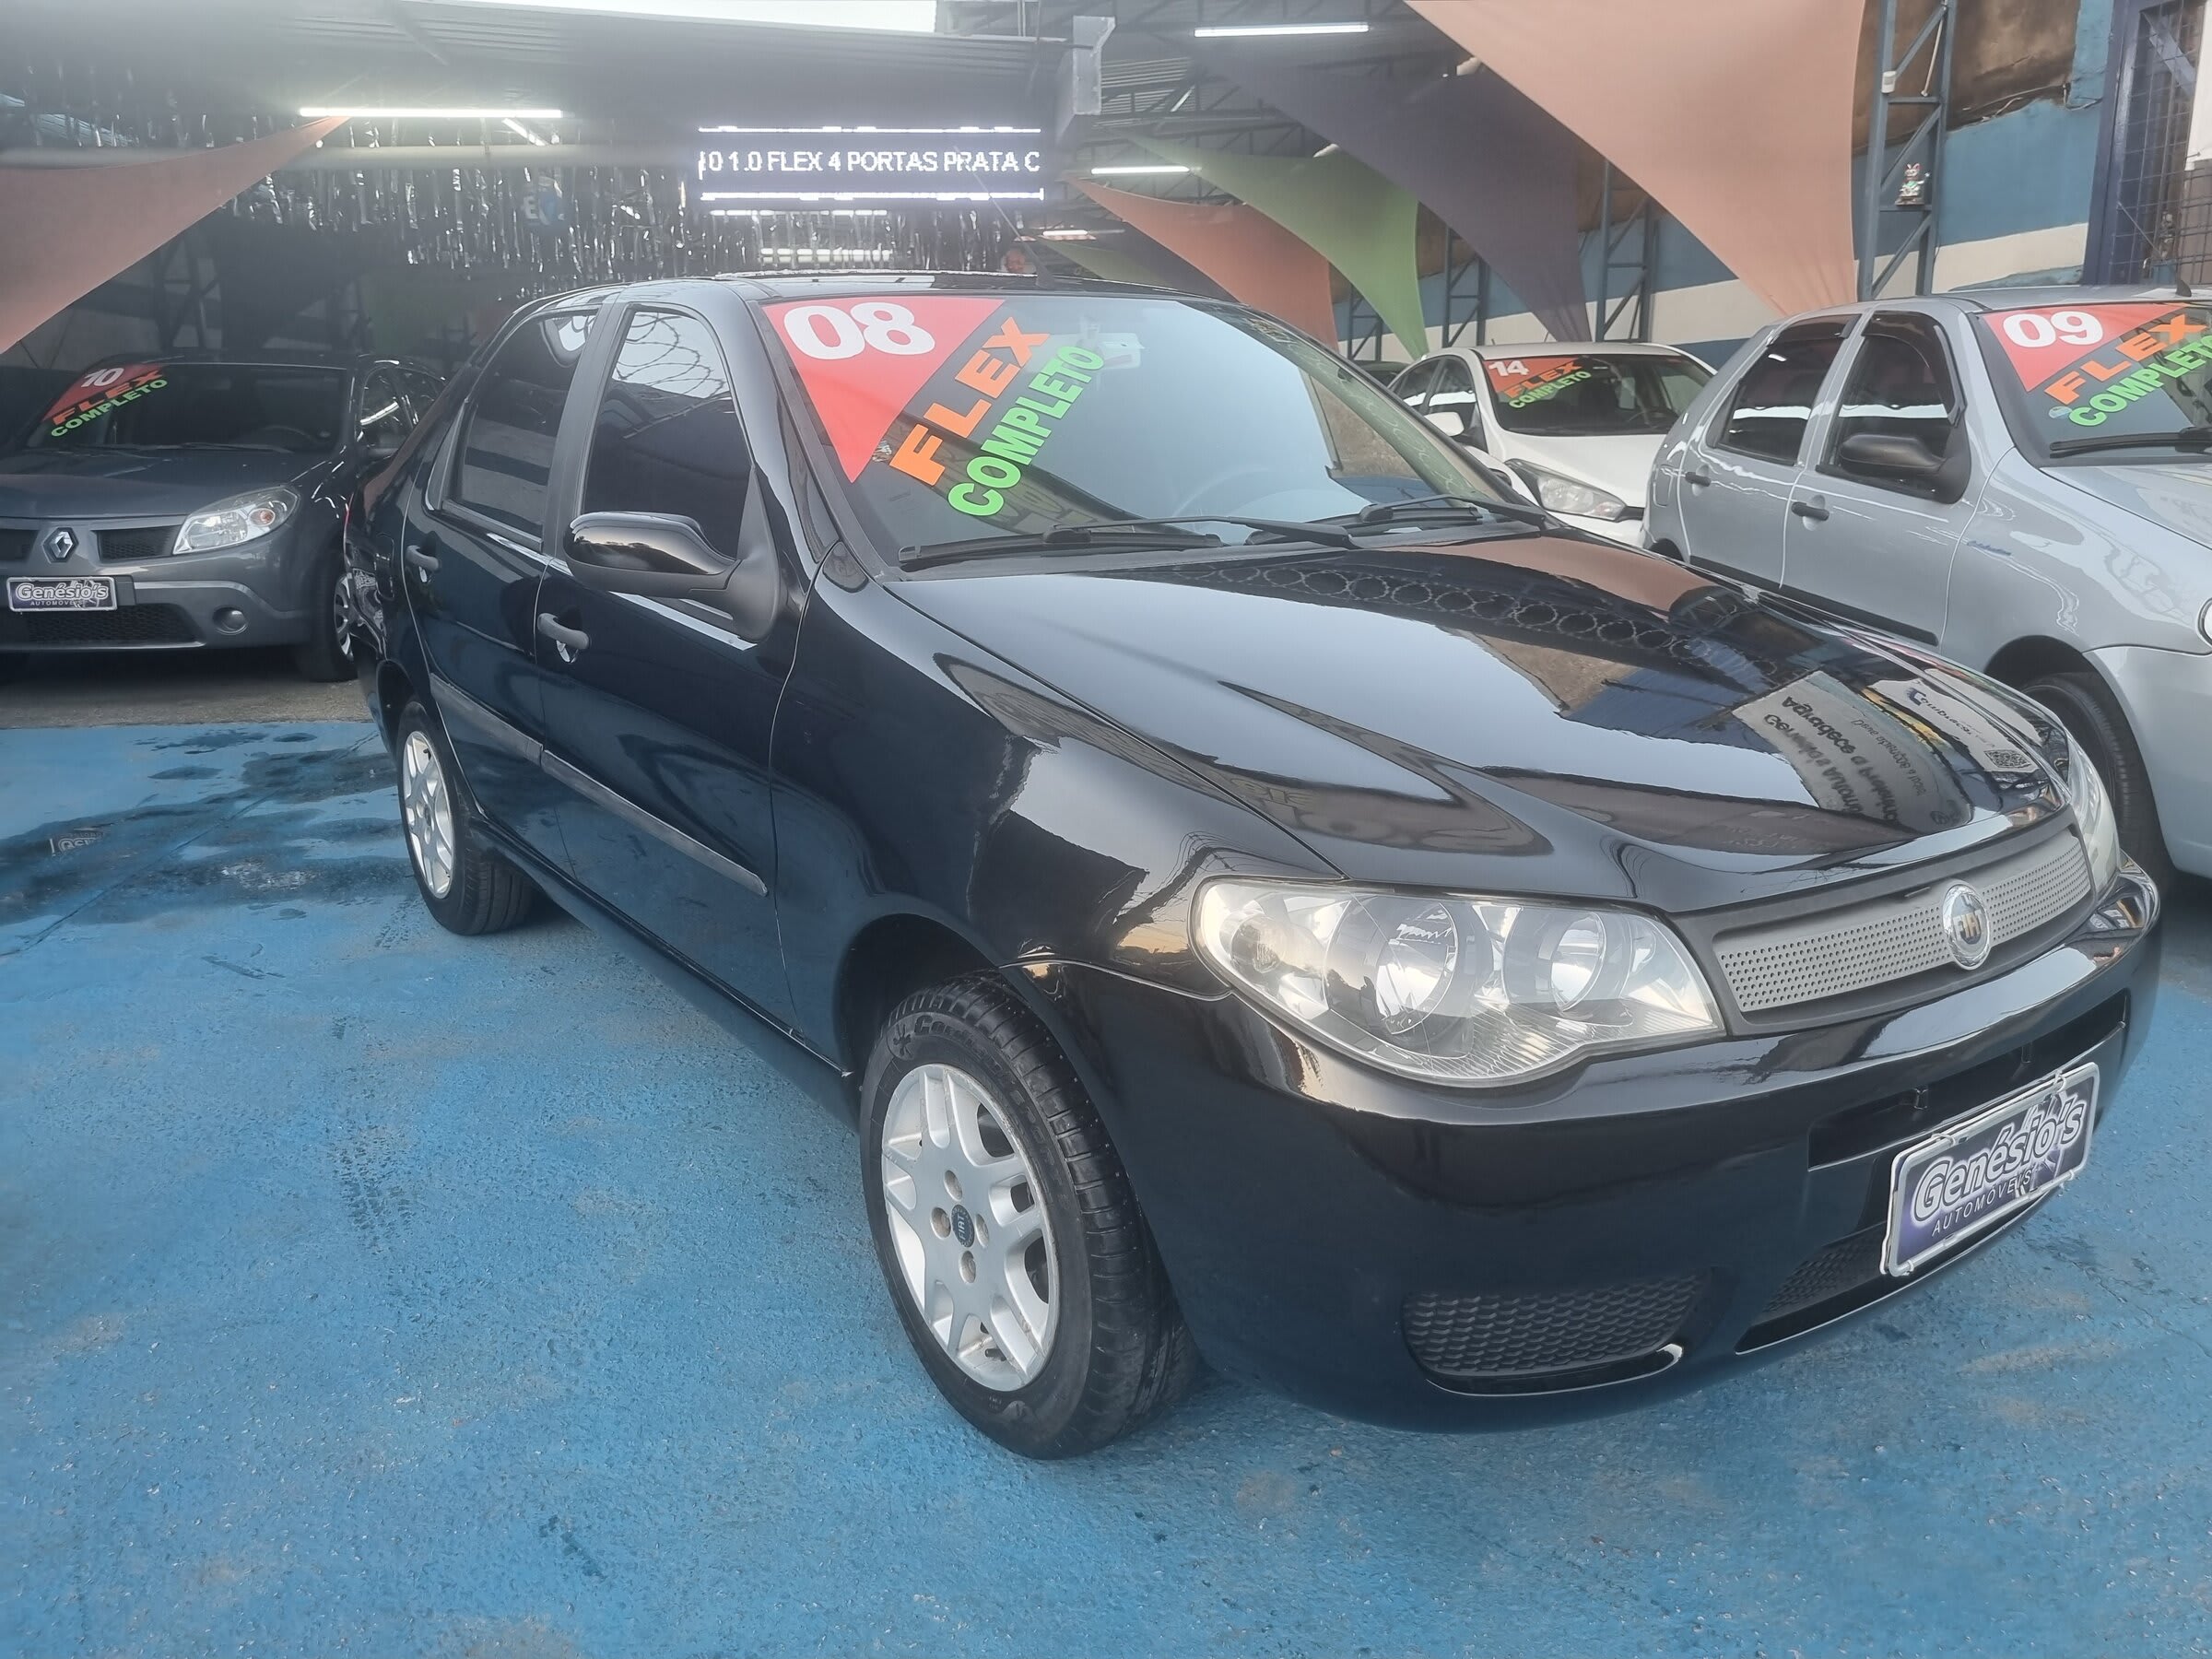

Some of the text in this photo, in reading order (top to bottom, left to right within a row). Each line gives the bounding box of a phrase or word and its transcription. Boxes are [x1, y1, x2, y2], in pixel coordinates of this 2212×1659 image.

[728, 151, 762, 171] 1.0
[767, 151, 824, 171] FLEX
[828, 151, 841, 171] 4
[847, 151, 938, 172] PORTAS
[943, 151, 1020, 172] PRATA
[783, 301, 936, 360] 08
[2003, 311, 2104, 348] 09
[81, 367, 124, 388] 10
[1488, 359, 1530, 378] 14
[1502, 361, 1583, 399] FLEX
[2043, 313, 2208, 406] FLEX
[51, 379, 168, 438] COMPLETO
[52, 369, 163, 426] FLEX
[888, 316, 1051, 487] FLEX
[1509, 371, 1593, 409] COMPLETO
[947, 346, 1104, 517] COMPLETO
[17, 582, 110, 601] Genésio's
[1912, 1094, 2087, 1224] Genésio's
[1932, 1169, 2032, 1237] AUTOMÓVEIS
[958, 1213, 966, 1241] FIAT
